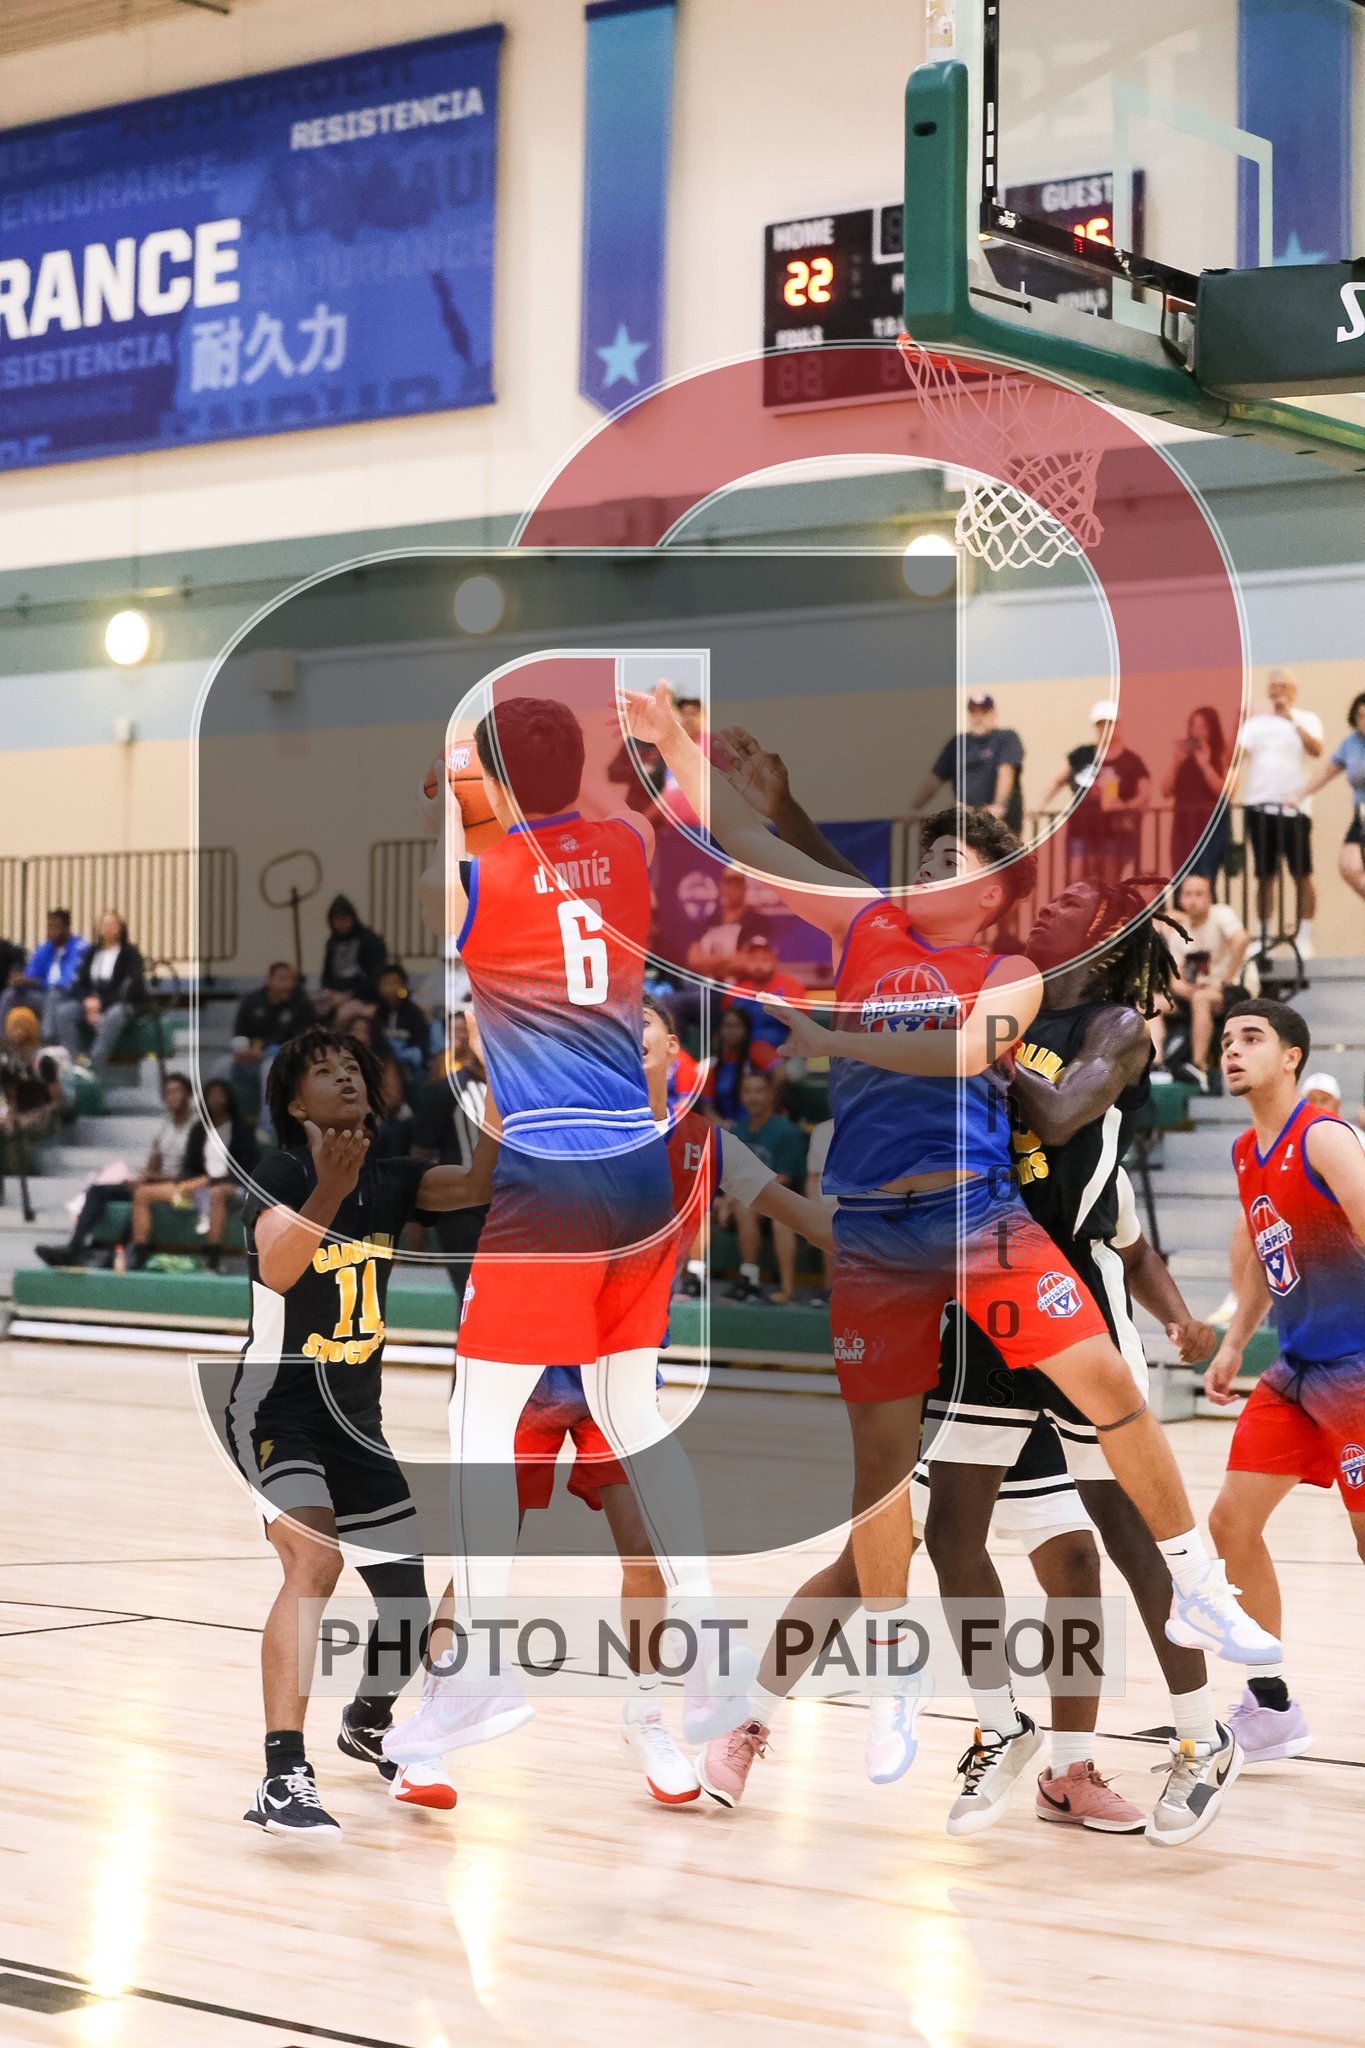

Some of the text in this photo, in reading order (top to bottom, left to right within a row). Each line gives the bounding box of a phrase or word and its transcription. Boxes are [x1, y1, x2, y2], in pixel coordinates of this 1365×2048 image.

[290, 87, 485, 151] RESISTENCIA
[0, 218, 242, 341] RANCE
[783, 257, 834, 307] 22
[190, 302, 348, 393] 耐久力
[557, 897, 609, 1006] 6
[862, 1001, 957, 1022] PROSPECT
[333, 1259, 382, 1339] 11
